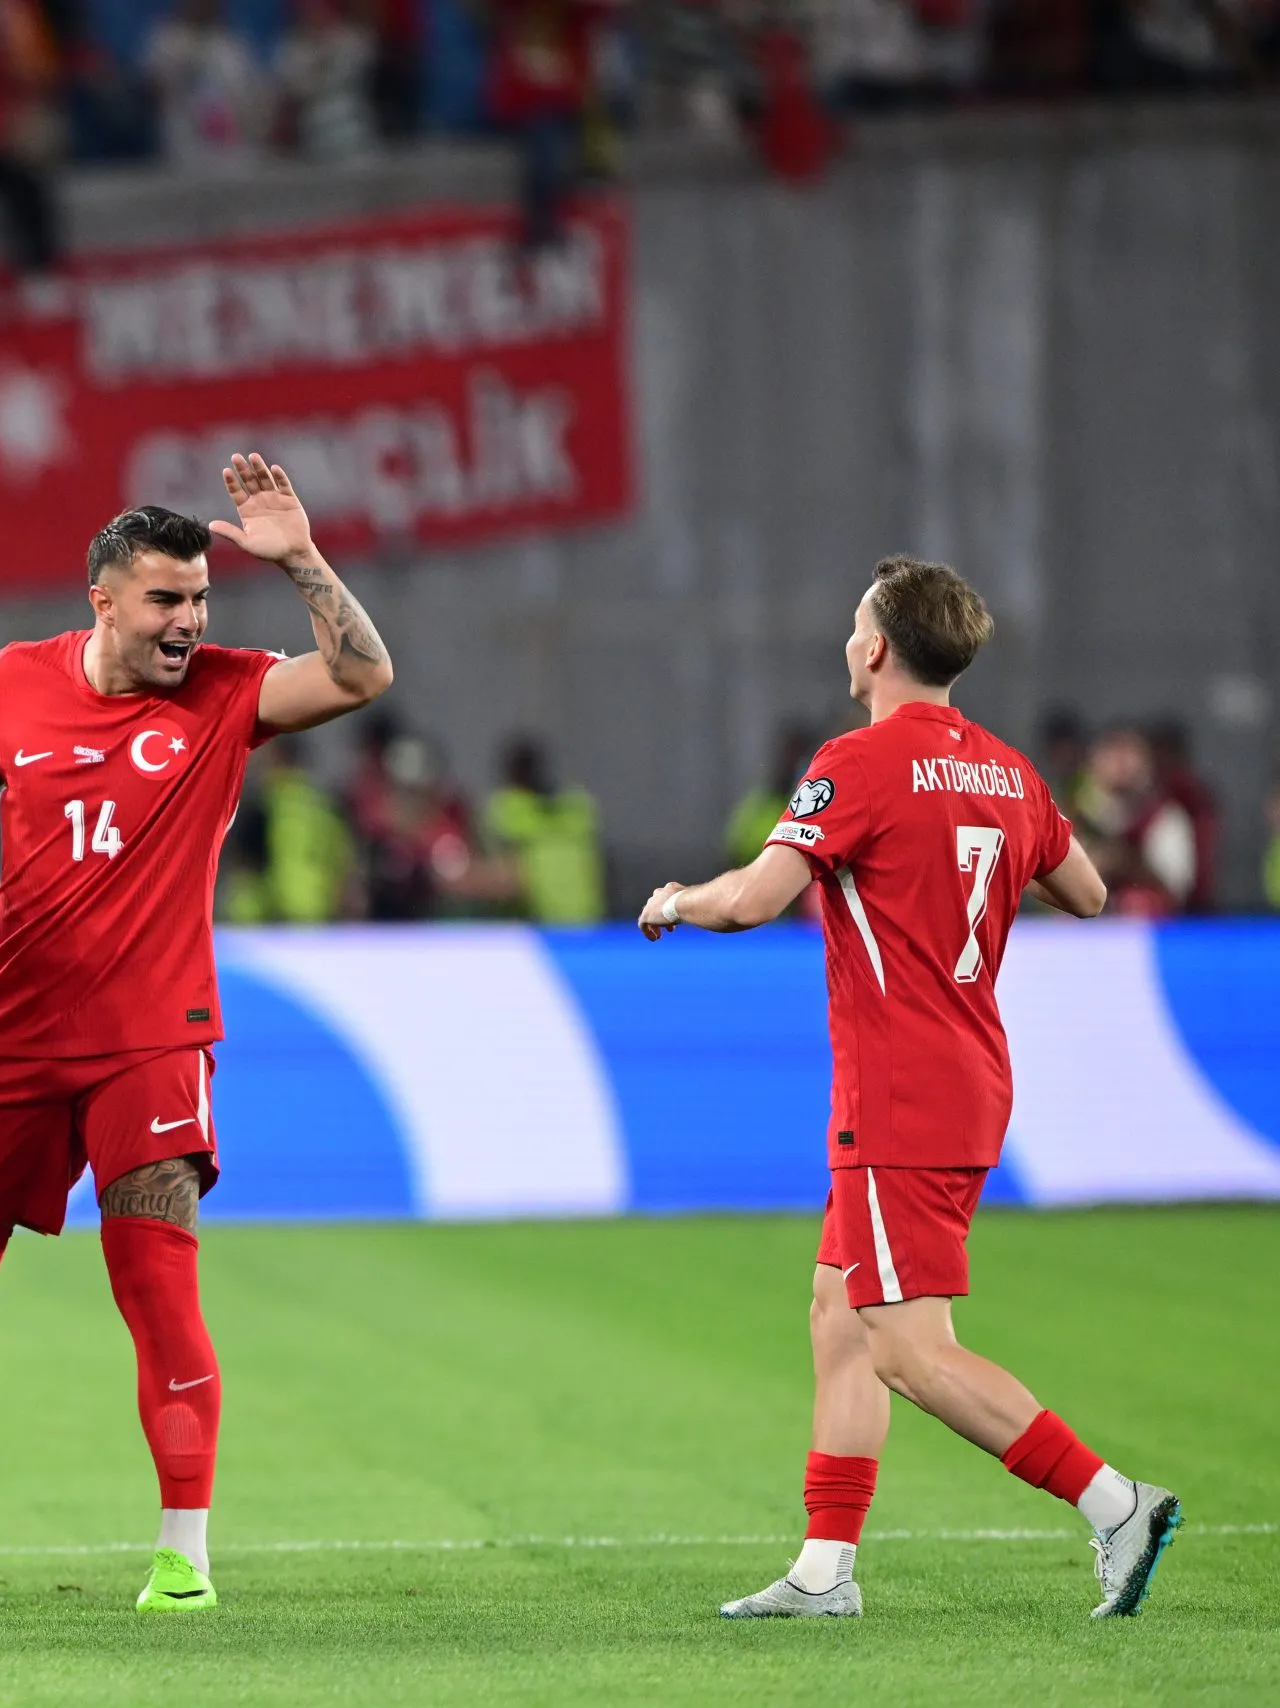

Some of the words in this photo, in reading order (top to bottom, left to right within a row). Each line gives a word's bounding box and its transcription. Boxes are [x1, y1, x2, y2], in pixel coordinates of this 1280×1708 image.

[911, 754, 1025, 800] AKTÜRKOĞLU
[64, 799, 125, 862] 14
[953, 825, 1006, 984] 7
